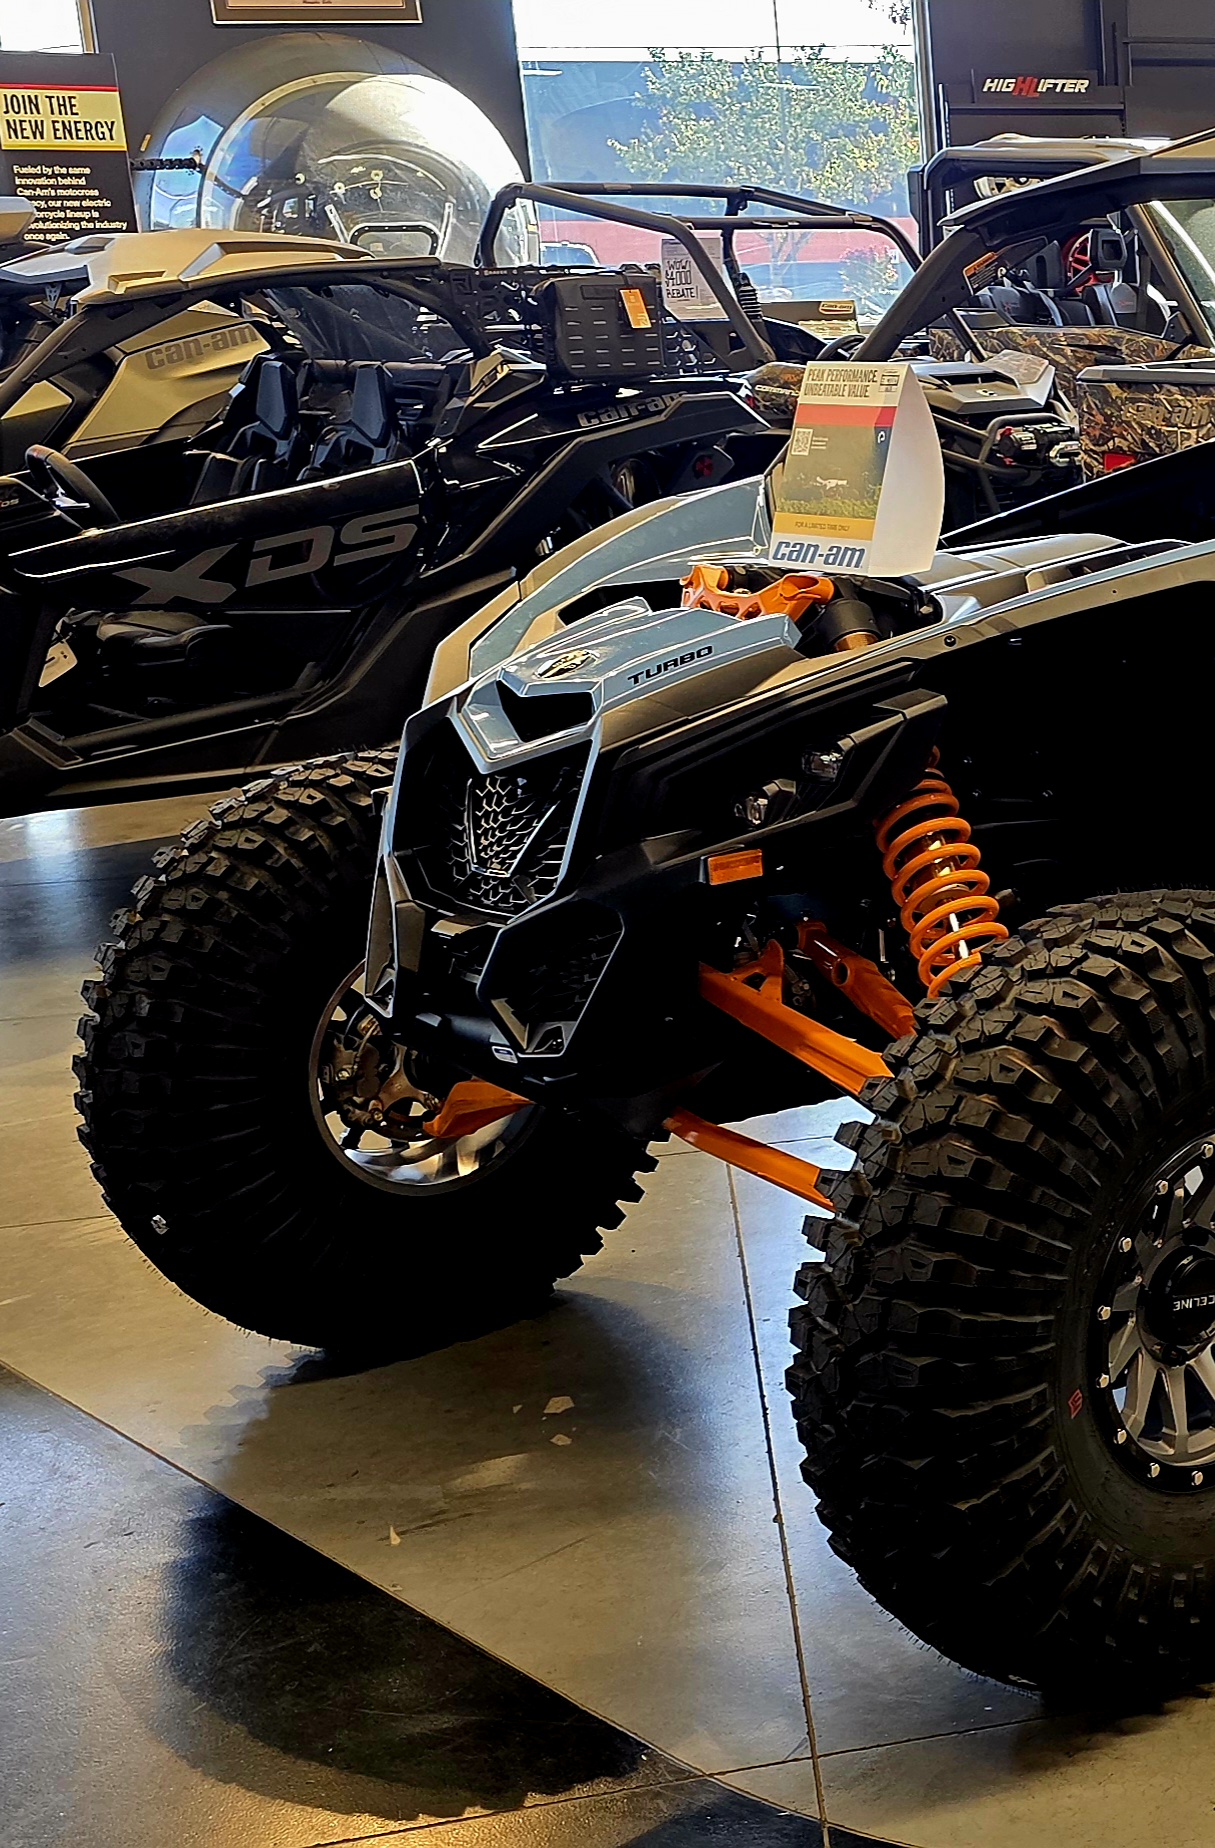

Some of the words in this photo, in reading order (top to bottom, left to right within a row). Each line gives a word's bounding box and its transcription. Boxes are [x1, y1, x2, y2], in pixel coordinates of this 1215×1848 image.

[3, 93, 41, 115] JOIN
[45, 95, 79, 116] THE
[6, 118, 45, 140] NEW
[51, 120, 116, 141] ENERGY
[13, 165, 41, 174] Fueled
[42, 165, 53, 176] by
[53, 166, 67, 175] the
[68, 167, 91, 175] same
[15, 175, 57, 185] innovation
[57, 176, 86, 185] behind
[16, 187, 56, 196] Can-Am's
[57, 188, 99, 197] motocross
[48, 200, 62, 208] our
[63, 200, 81, 208] new
[81, 198, 112, 207] electric
[35, 209, 66, 219] orcycle
[66, 209, 91, 219] lineup
[91, 209, 100, 218] is
[28, 220, 80, 231] volutionizing
[81, 220, 94, 229] the
[95, 220, 127, 231] industry
[23, 233, 45, 241] once
[45, 231, 71, 241] again.
[144, 325, 259, 370] can-am
[807, 368, 825, 382] PEAK
[804, 382, 847, 397] UNBEATABLE
[111, 503, 420, 605] XDS
[772, 540, 867, 570] can-am
[627, 645, 713, 685] TURBO
